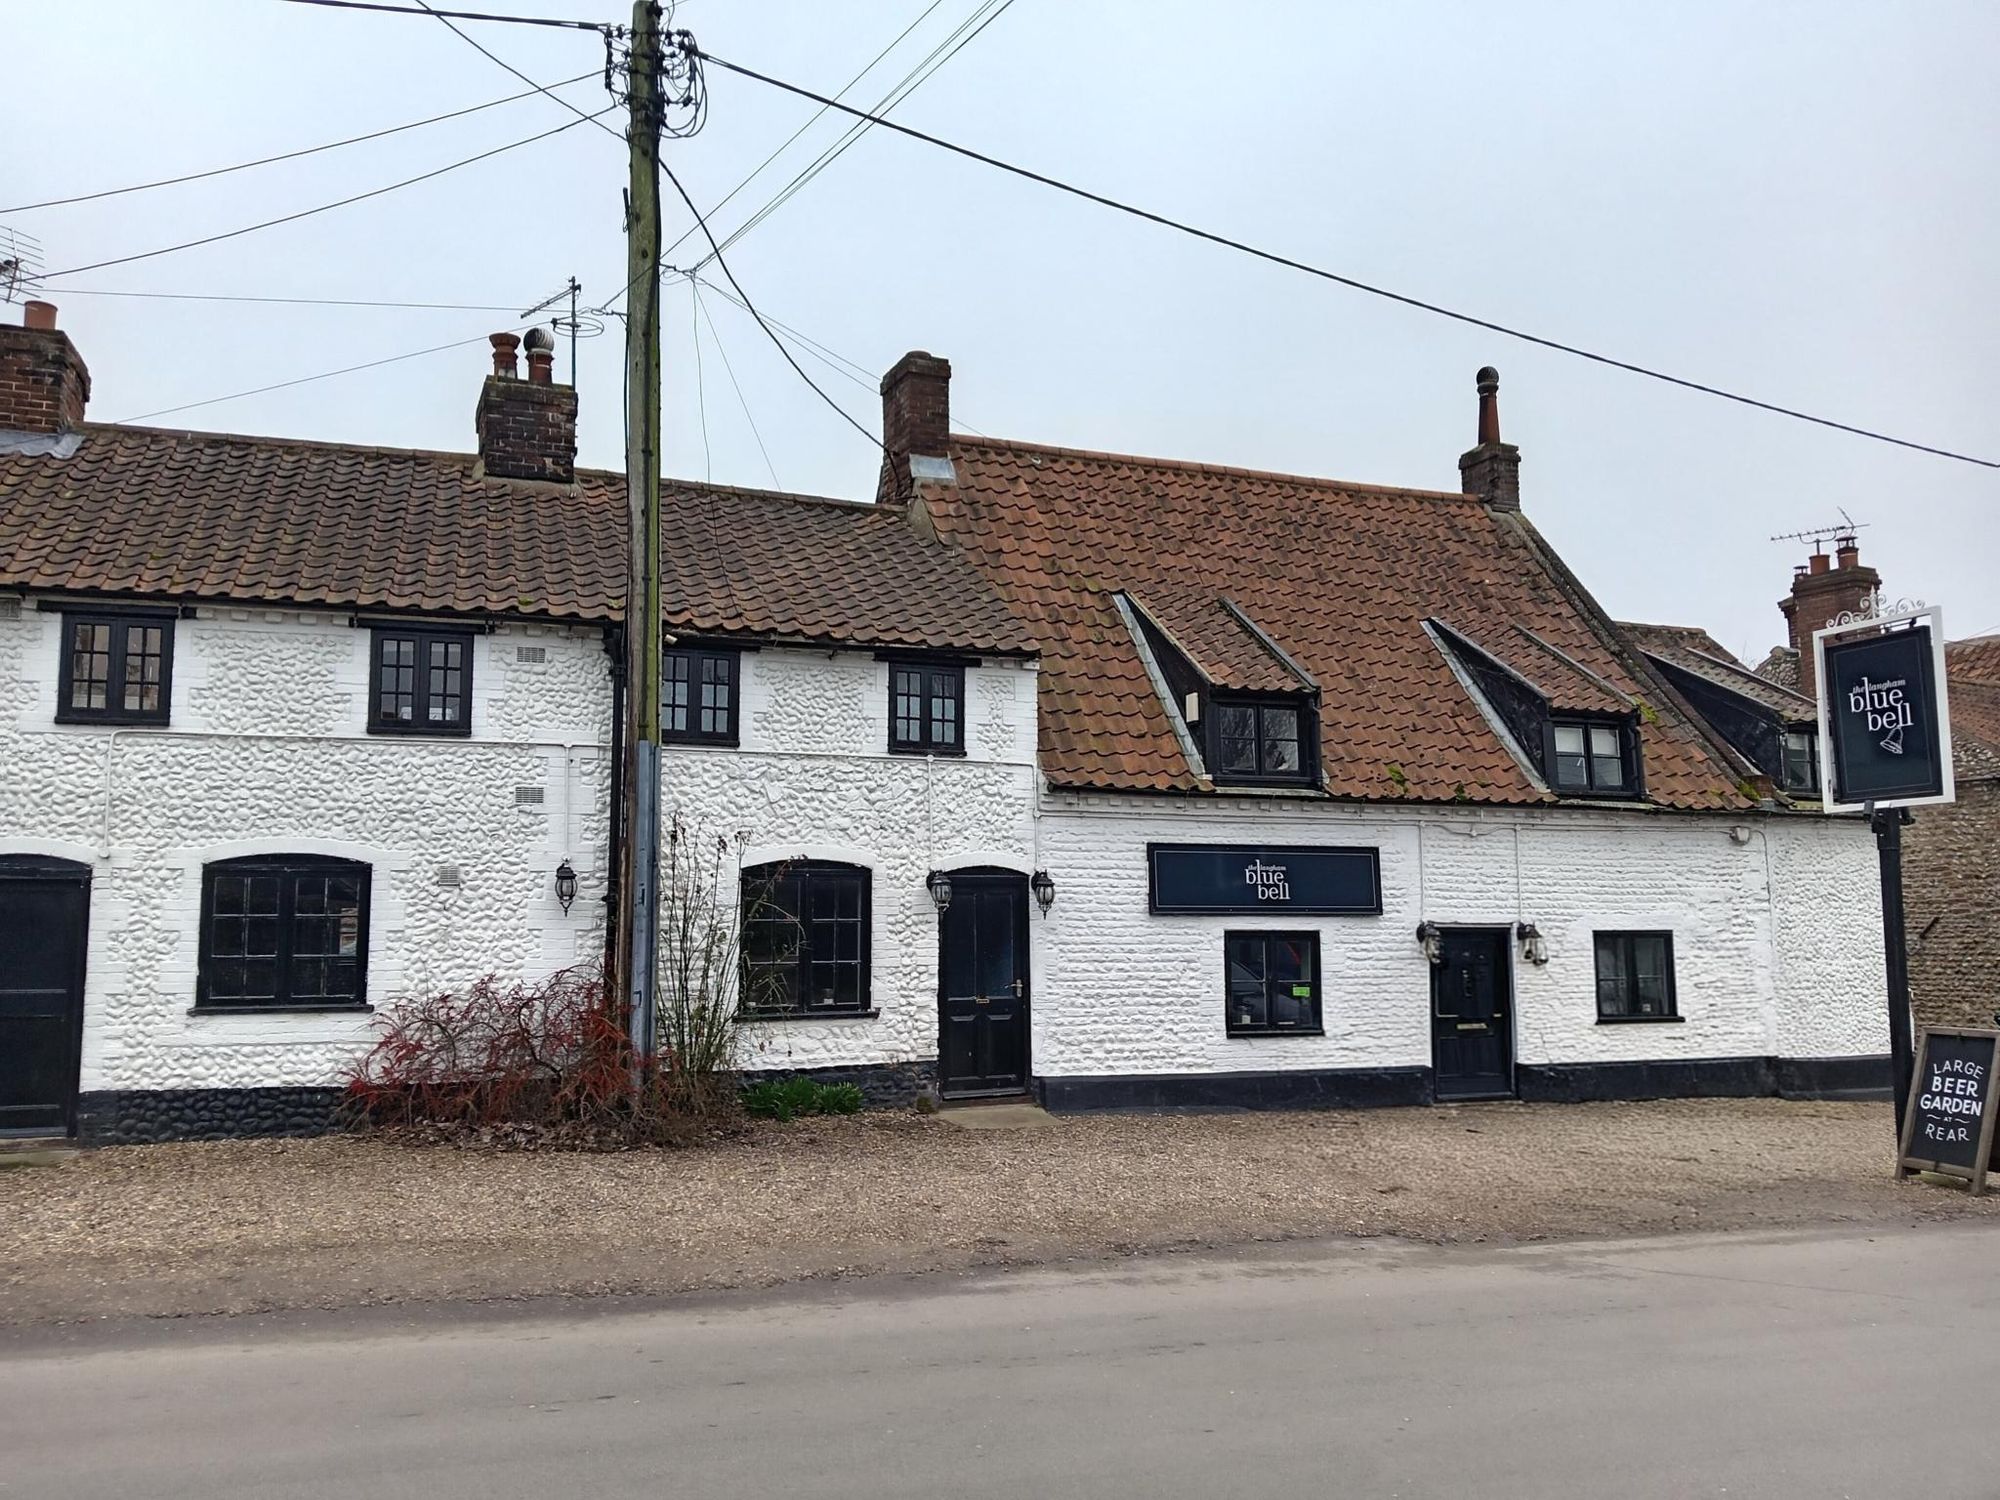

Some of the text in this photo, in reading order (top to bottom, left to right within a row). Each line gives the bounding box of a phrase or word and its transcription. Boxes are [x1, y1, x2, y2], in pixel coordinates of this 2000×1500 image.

[1848, 676, 1904, 713] blue
[1867, 702, 1914, 732] bell
[1244, 859, 1284, 885] blue
[1257, 882, 1291, 900] bell
[1933, 1059, 1984, 1080] LARGE
[1931, 1076, 1979, 1098] BEER
[1920, 1093, 1983, 1117] GARDEN
[1925, 1123, 1971, 1142] REAR
